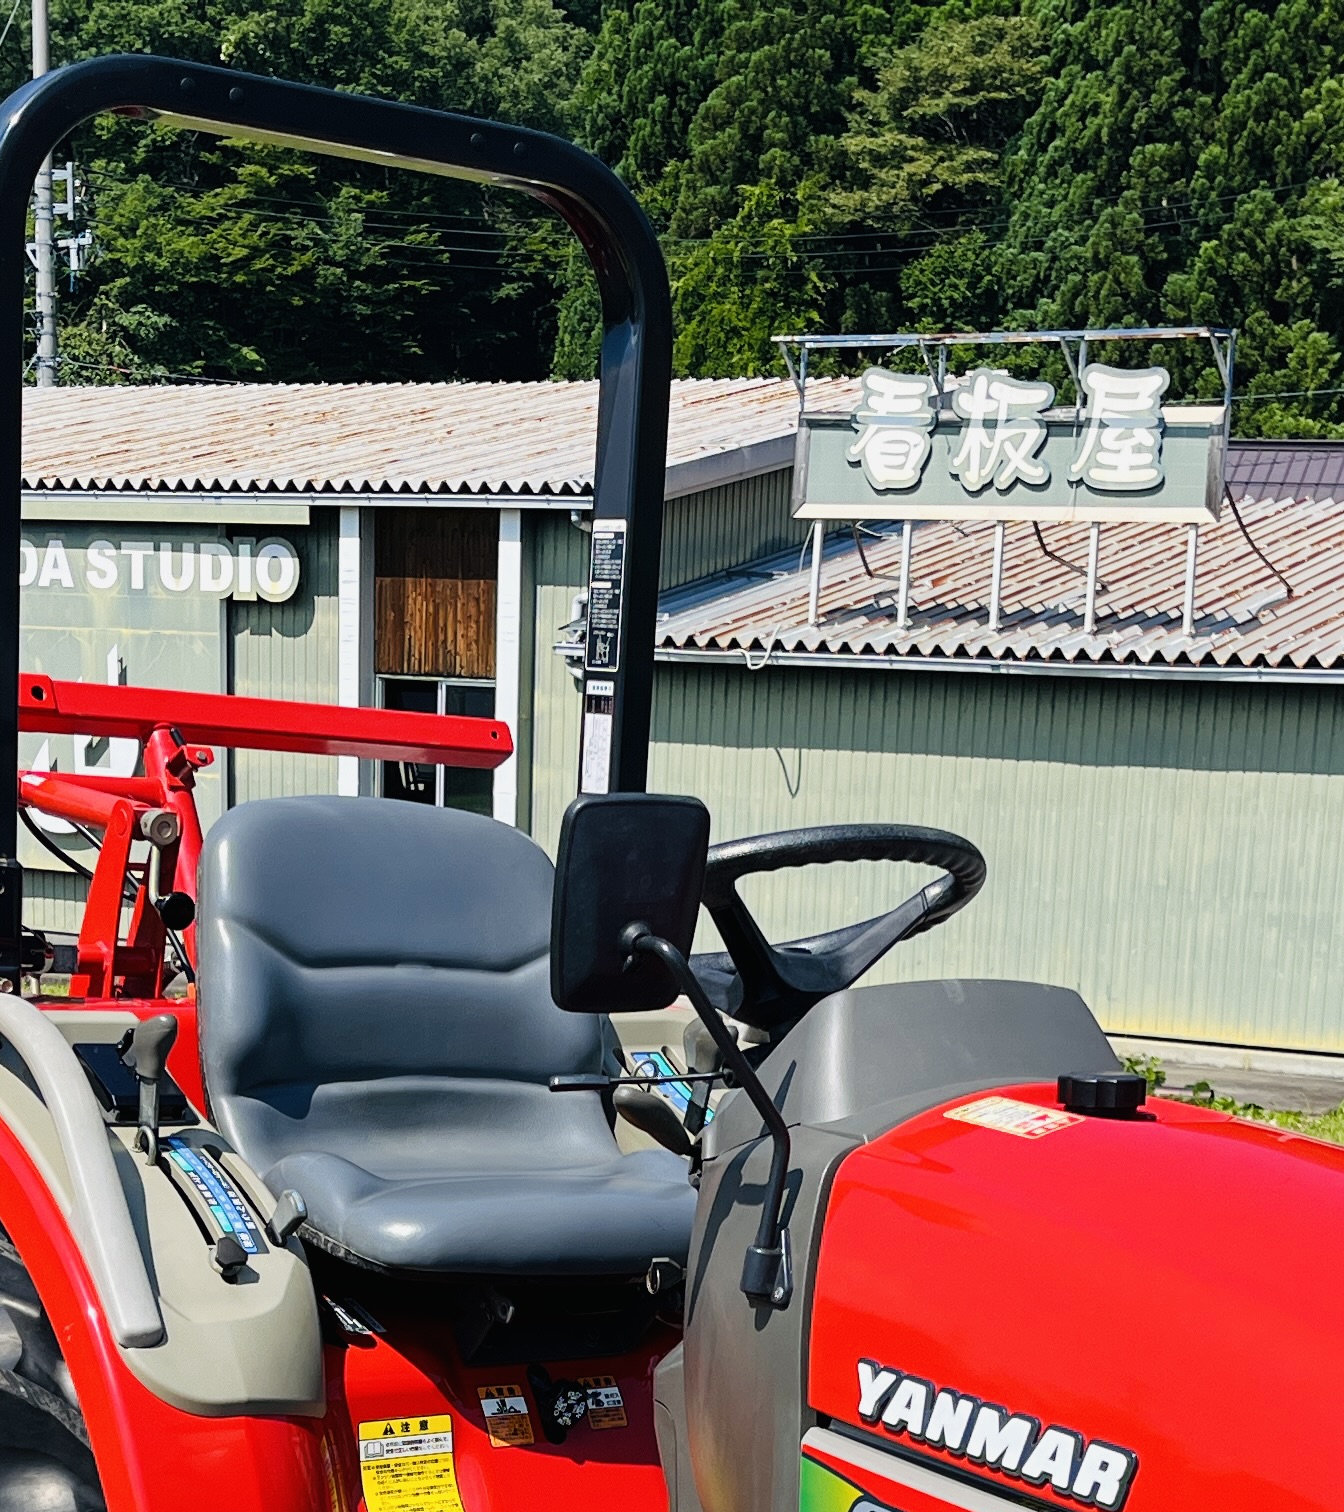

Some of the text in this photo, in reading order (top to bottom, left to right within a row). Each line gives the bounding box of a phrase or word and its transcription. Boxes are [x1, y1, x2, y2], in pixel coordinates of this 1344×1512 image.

[846, 364, 1169, 491] 看板屋
[84, 537, 298, 598] STUDIO
[857, 1358, 1136, 1512] YANMAR
